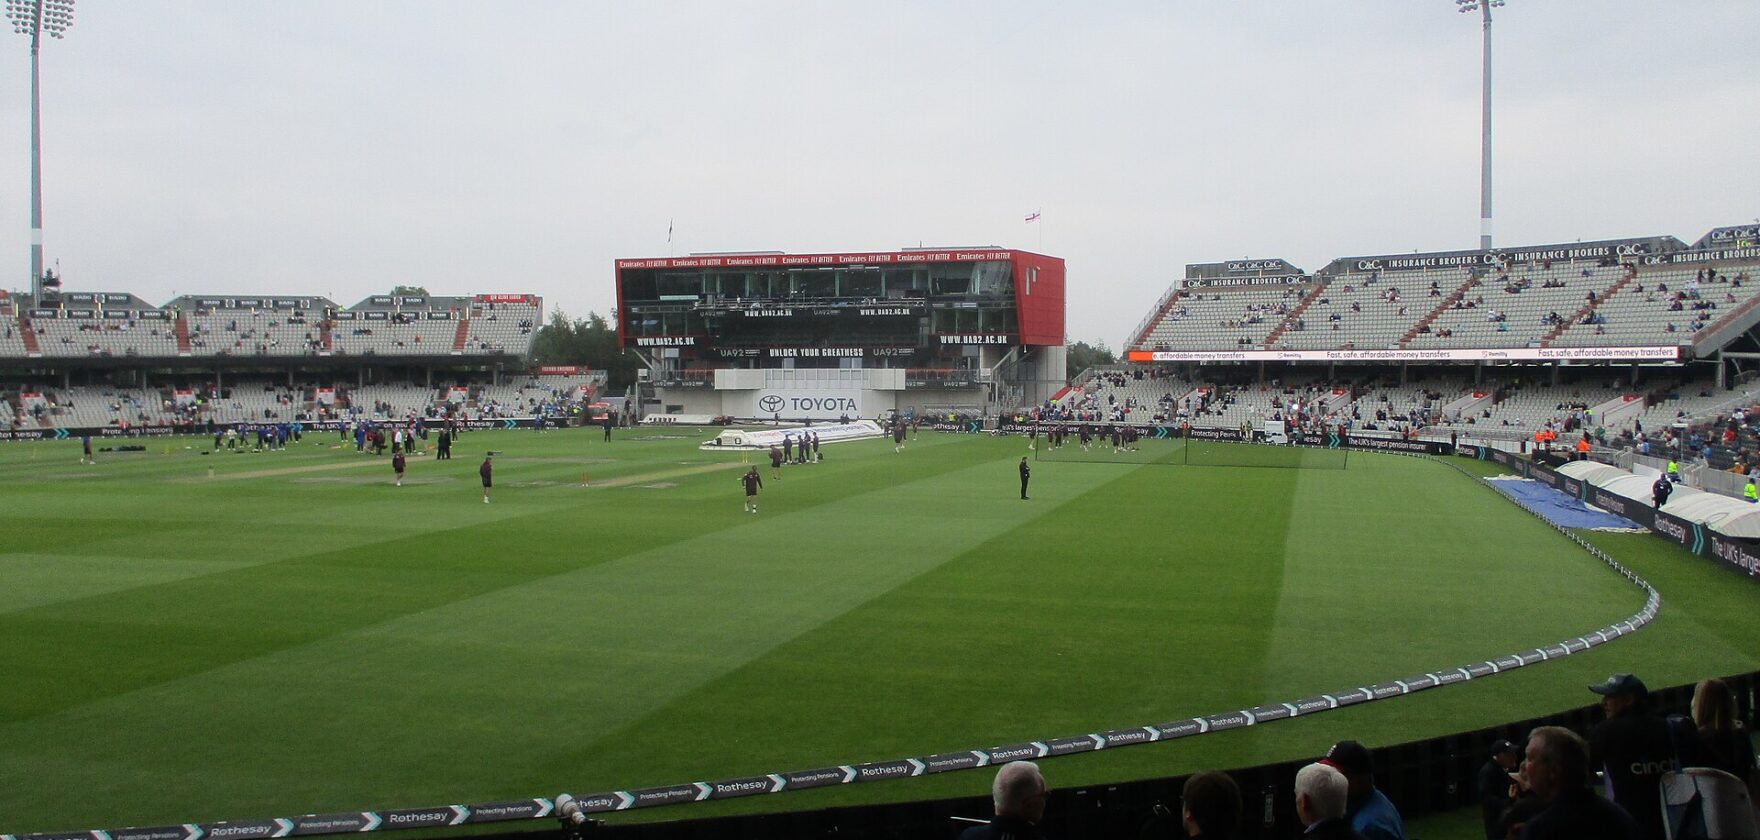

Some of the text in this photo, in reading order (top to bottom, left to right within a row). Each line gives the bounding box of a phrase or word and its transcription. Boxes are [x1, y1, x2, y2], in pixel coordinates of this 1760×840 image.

[840, 254, 866, 262] Emirates
[1514, 250, 1564, 261] INSURANCE
[1568, 248, 1609, 258] BROKERS
[1672, 252, 1720, 262] INSURANCE
[782, 256, 809, 264] Emirates
[1389, 258, 1434, 268] INSURANCE
[1440, 256, 1478, 266] BROKERS
[1252, 278, 1282, 286] BROKERS
[637, 337, 694, 346] WWW.UA92.AC.UK
[940, 335, 1007, 344] WWW.UA92.AC.UK
[721, 350, 744, 358] UA92
[770, 348, 864, 356] UNLOCK YOUR GREATNESS
[873, 348, 898, 356] UA92
[1398, 352, 1419, 360] money
[1614, 350, 1638, 358] money
[790, 398, 857, 411] TOYOTA
[1191, 430, 1222, 438] Protecting
[1348, 438, 1427, 450] The UK's largest pension insurer
[1654, 514, 1686, 544] Rothesay
[1712, 536, 1723, 557] The
[1108, 732, 1146, 742] Rothesay
[992, 748, 1033, 759] Rothesay
[862, 764, 908, 776] Rothesay
[818, 772, 839, 780] Pensions
[718, 780, 768, 792] Rothesay
[640, 789, 692, 800] Protecting Pensions
[578, 798, 614, 809] hesay
[476, 805, 532, 816] Protecting Pensions
[390, 812, 448, 823] Rothesay
[211, 826, 272, 837] Rothesay
